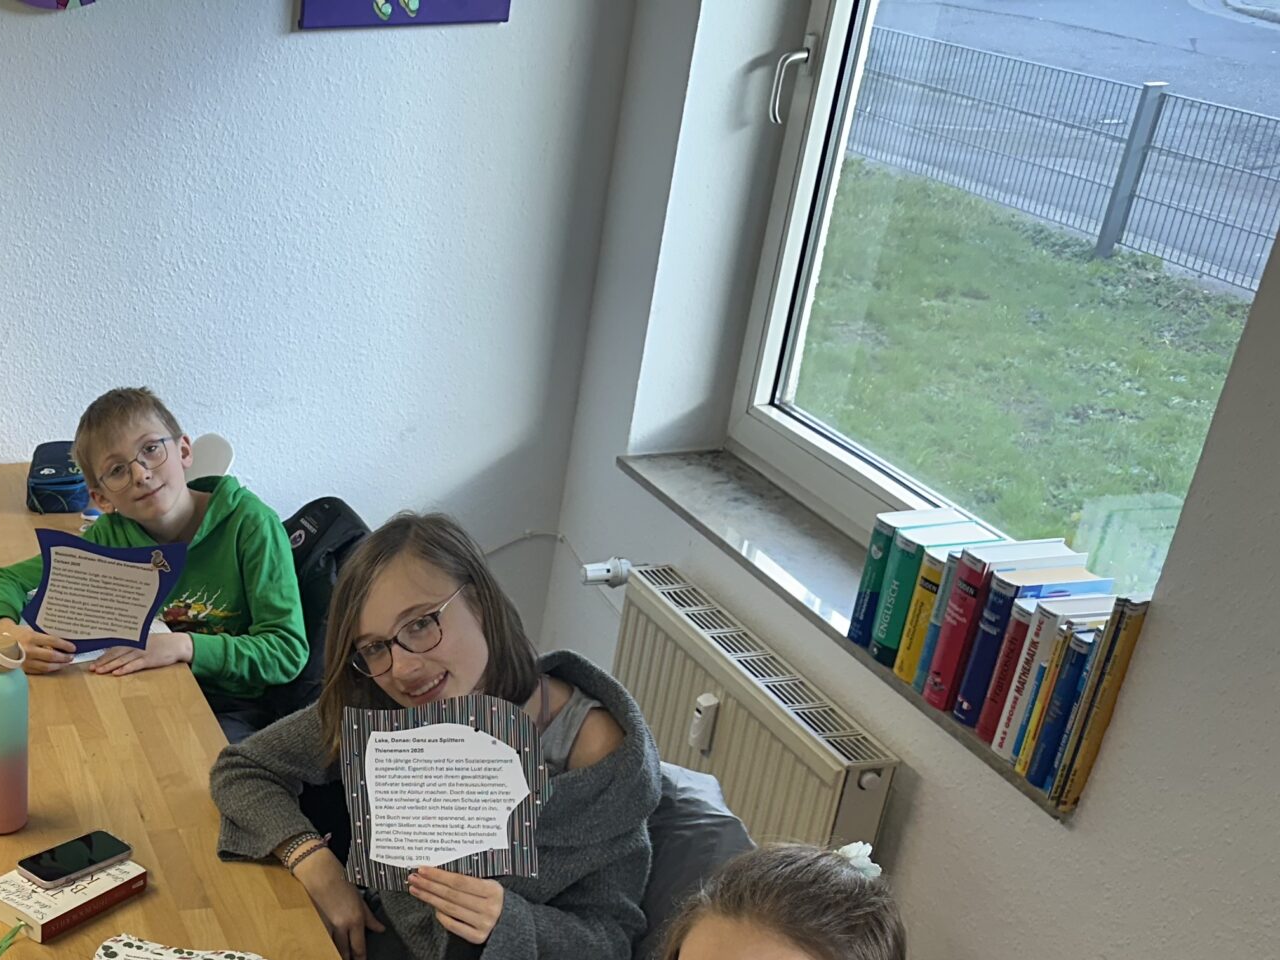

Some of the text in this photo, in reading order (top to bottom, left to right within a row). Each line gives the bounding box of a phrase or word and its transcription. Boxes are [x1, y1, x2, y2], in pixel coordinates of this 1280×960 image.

[878, 579, 900, 638] ENGLISCH
[998, 618, 1045, 749] DAS GROSSE MATHEMATIK BUC
